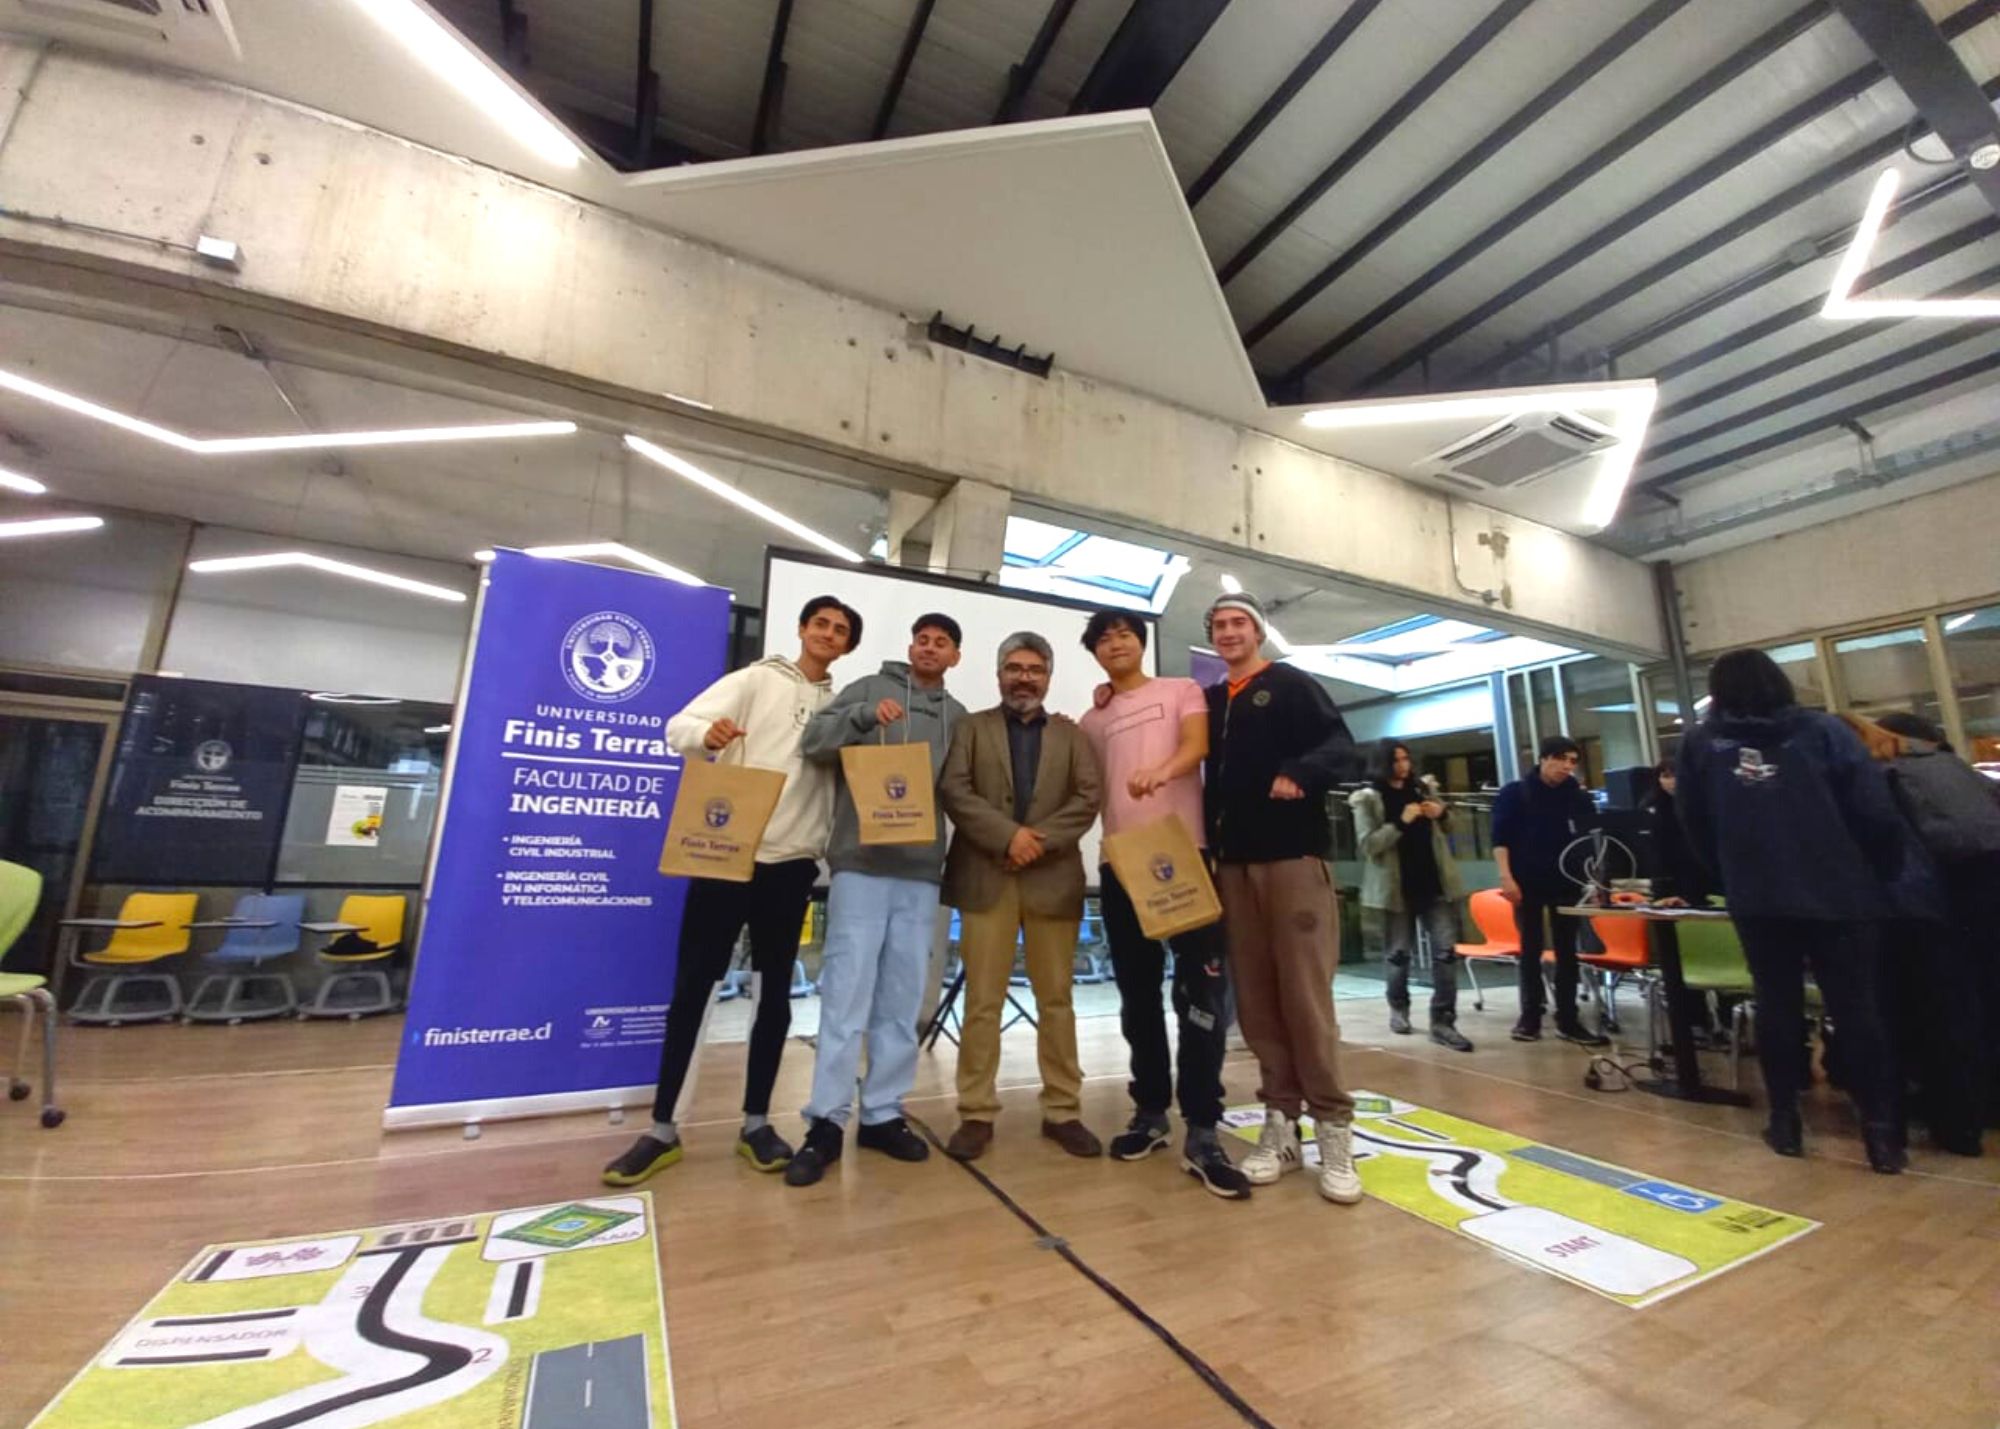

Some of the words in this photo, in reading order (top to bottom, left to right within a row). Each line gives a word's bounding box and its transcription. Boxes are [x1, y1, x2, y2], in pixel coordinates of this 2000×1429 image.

[536, 704, 662, 728] UNIVERSIDAD
[503, 719, 582, 750] Finis
[513, 767, 631, 793] FACULTAD
[635, 776, 665, 795] DE
[509, 793, 661, 819] INGENIERÍA
[511, 834, 583, 846] INGENIERÍA
[509, 847, 543, 857] CIVIL
[544, 848, 616, 859] INDUSTRIAL
[504, 870, 577, 881] INGENIERÍA
[578, 872, 610, 882] CIVIL
[503, 883, 521, 893] EN
[523, 883, 608, 894] INFORMÁTICA
[502, 896, 512, 905] Y
[424, 1022, 553, 1047] finisterrae.cl
[1543, 1235, 1601, 1258] START
[471, 1347, 493, 1364] 2
